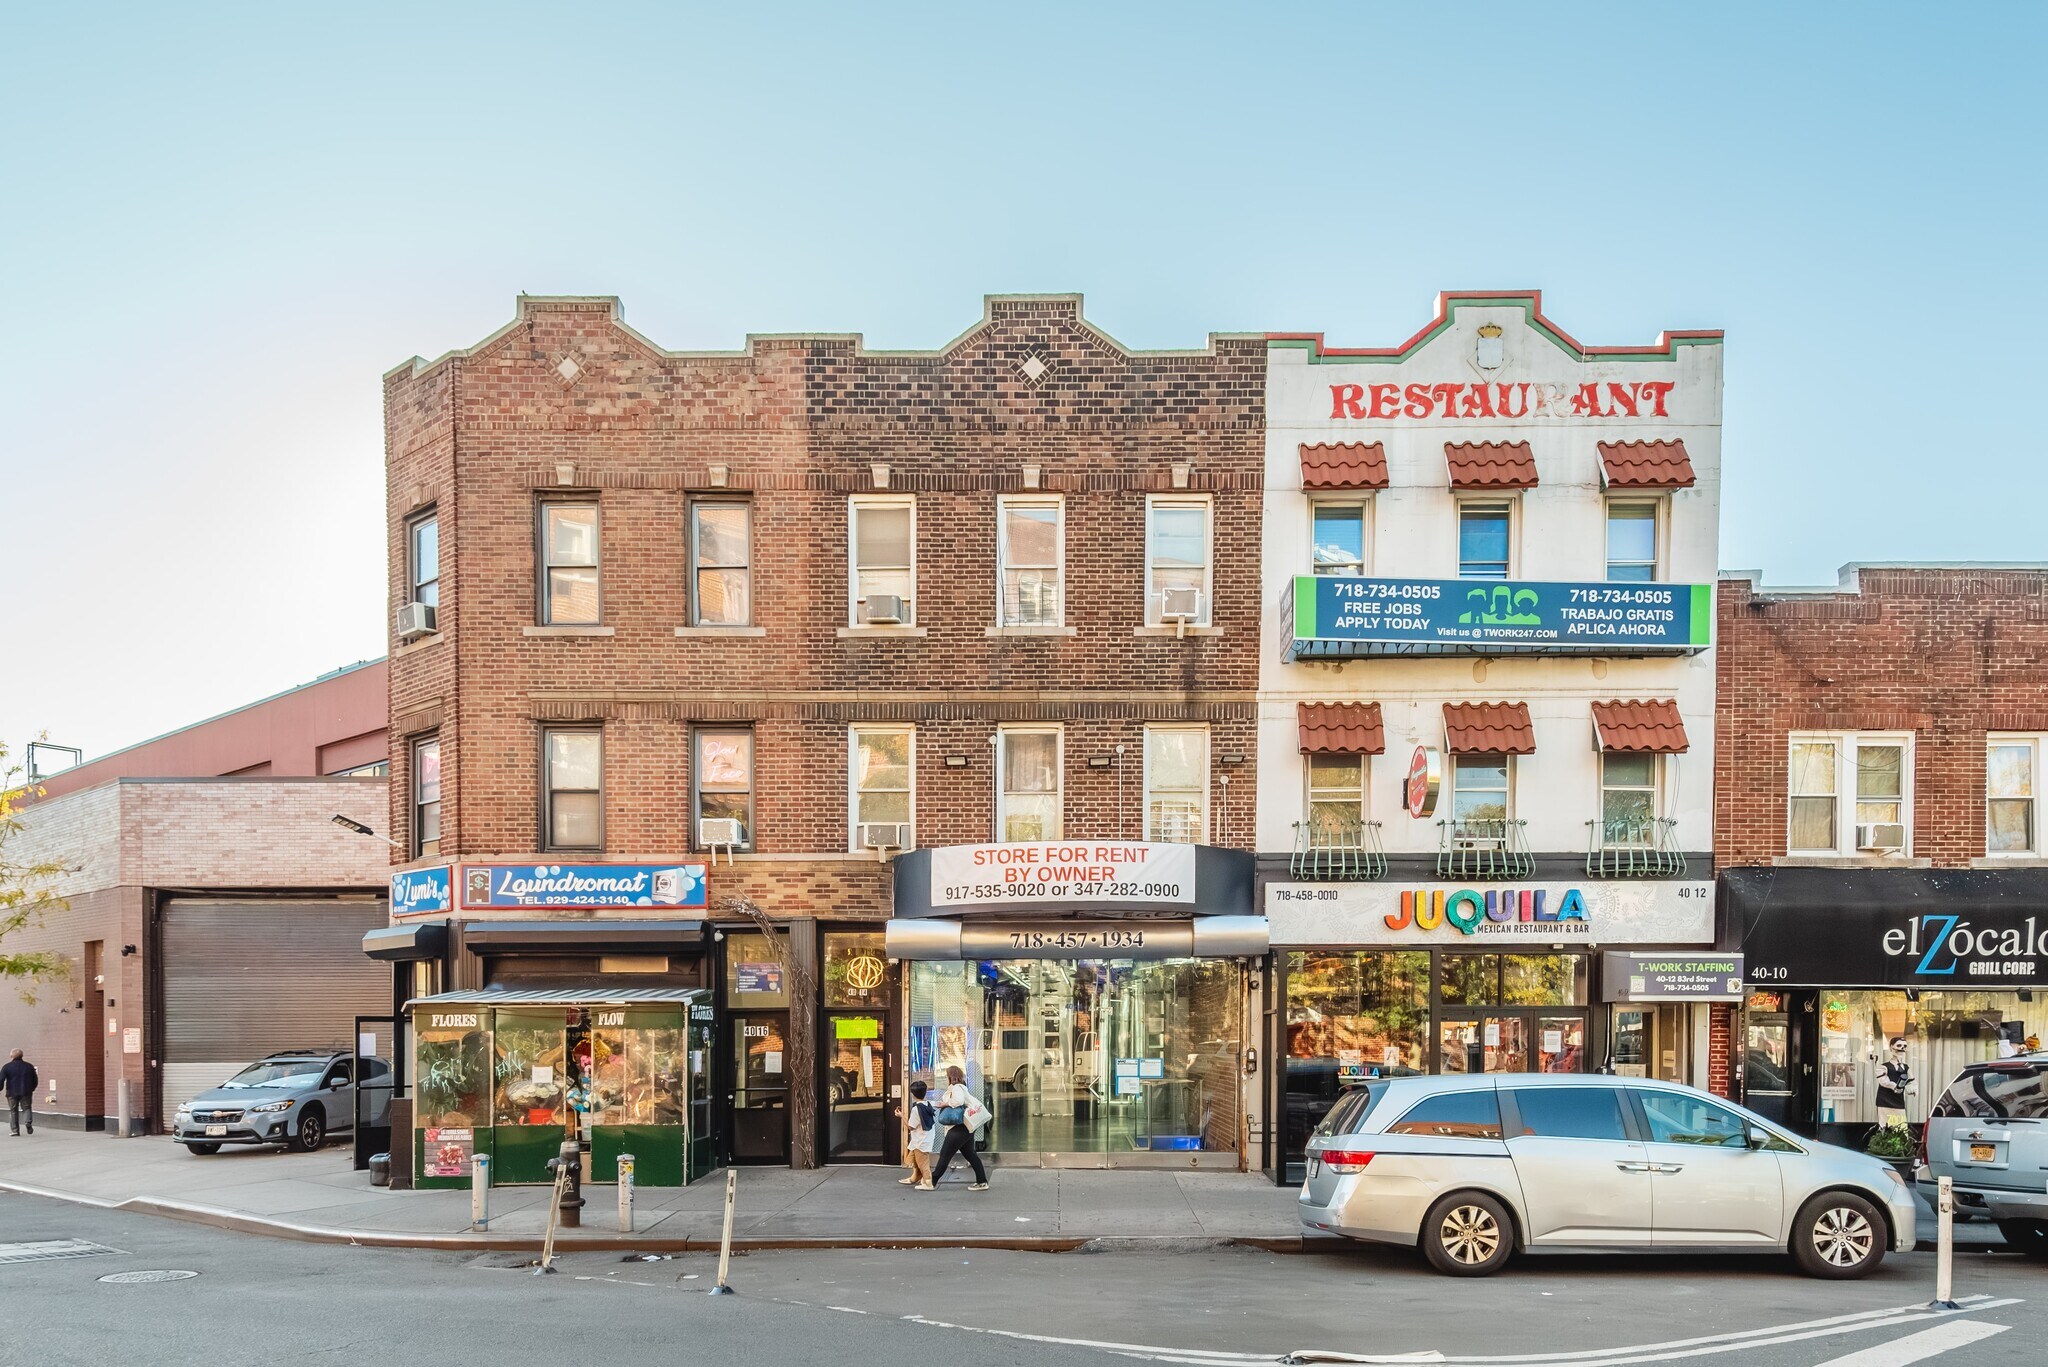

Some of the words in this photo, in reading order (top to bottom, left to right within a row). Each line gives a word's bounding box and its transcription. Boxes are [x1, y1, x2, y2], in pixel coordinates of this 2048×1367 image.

[1329, 382, 1675, 420] RESTAURANT
[1334, 583, 1441, 599] 718-734-0505
[1570, 590, 1672, 604] 718-734-0505
[1344, 602, 1381, 614] FREE
[1384, 602, 1422, 615] JOBS
[1561, 608, 1623, 620] TRABAJO
[1626, 609, 1674, 621] GRATIS
[1335, 617, 1380, 629] APPLY
[1383, 618, 1431, 630] TODAY
[1567, 623, 1616, 635] APLICA
[1619, 624, 1666, 636] AHORA
[1437, 627, 1456, 636] Visit
[1472, 629, 1482, 638] @
[1484, 629, 1558, 639] TWORK247.COM
[974, 849, 1039, 866] STORE
[1046, 848, 1089, 864] FOR
[1095, 848, 1149, 864] RENT
[1004, 866, 1029, 883] BY
[1037, 866, 1116, 882] OWNER
[497, 870, 650, 896] Laundromat
[404, 876, 438, 906] Lumi's
[946, 882, 1046, 900] 917-535-9020
[1052, 885, 1069, 896] or
[1074, 882, 1180, 898] 347-282-0900
[1276, 890, 1338, 901] 718-458-0010
[1384, 888, 1592, 935] JUQUILA
[1478, 925, 1510, 934] MEXICAN
[1513, 925, 1564, 934] RESTAURANT
[1565, 925, 1572, 933] &
[1573, 925, 1590, 933] BAR
[1639, 963, 1682, 972] T-WORK
[1685, 962, 1734, 972] STAFFING
[1751, 967, 1788, 980] 40-10
[1969, 962, 2001, 975] GRILL
[2003, 962, 2036, 975] CORP.
[1664, 984, 1710, 992] 718-734-0505
[1748, 994, 1780, 1006] OPEN
[432, 1014, 477, 1027] FLORES
[1338, 1066, 1380, 1076] JUQUILA
